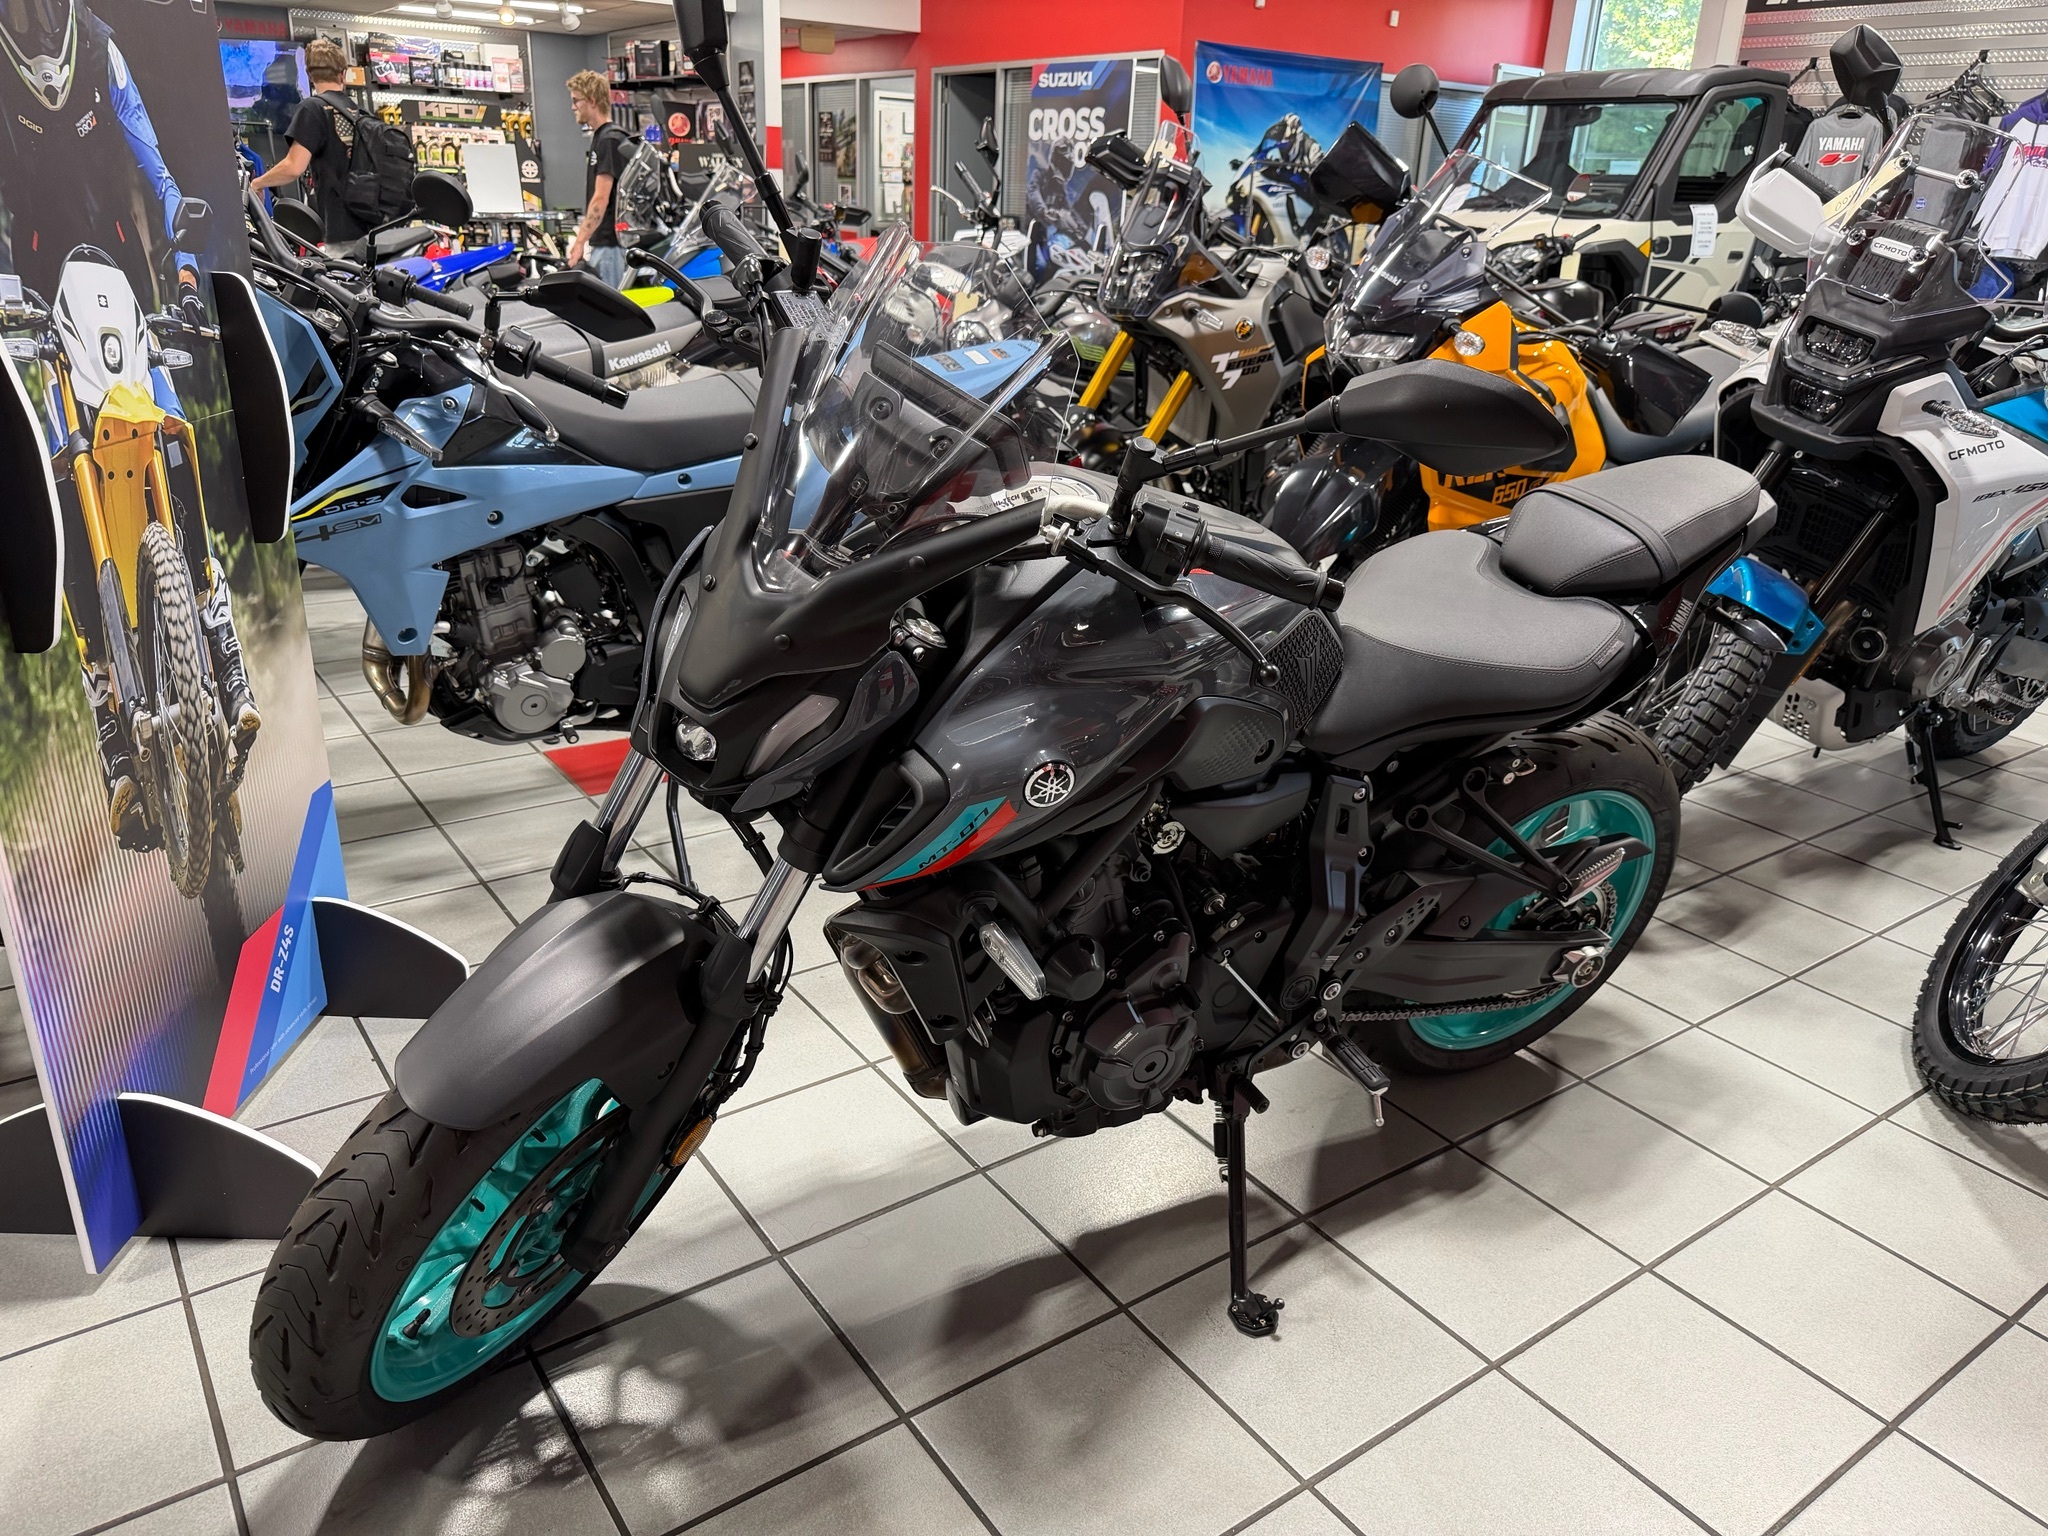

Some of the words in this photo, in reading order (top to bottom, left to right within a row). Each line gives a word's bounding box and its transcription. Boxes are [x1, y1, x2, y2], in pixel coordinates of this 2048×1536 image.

[224, 17, 287, 38] YAMAHA
[1038, 71, 1093, 88] SUZUKI
[1223, 64, 1274, 88] YAMAHA
[1028, 106, 1106, 141] CROSS
[1819, 137, 1866, 151] YAMAHA
[1873, 242, 1909, 257] CFMOTO
[608, 340, 672, 372] Kawasaki
[1948, 439, 2005, 461] CFMOTO
[1492, 477, 1528, 505] 650
[323, 495, 382, 515] DR-Z
[1668, 598, 1694, 635] YAMAHA
[918, 806, 989, 869] MT-07
[270, 924, 294, 994] DR-Z4S
